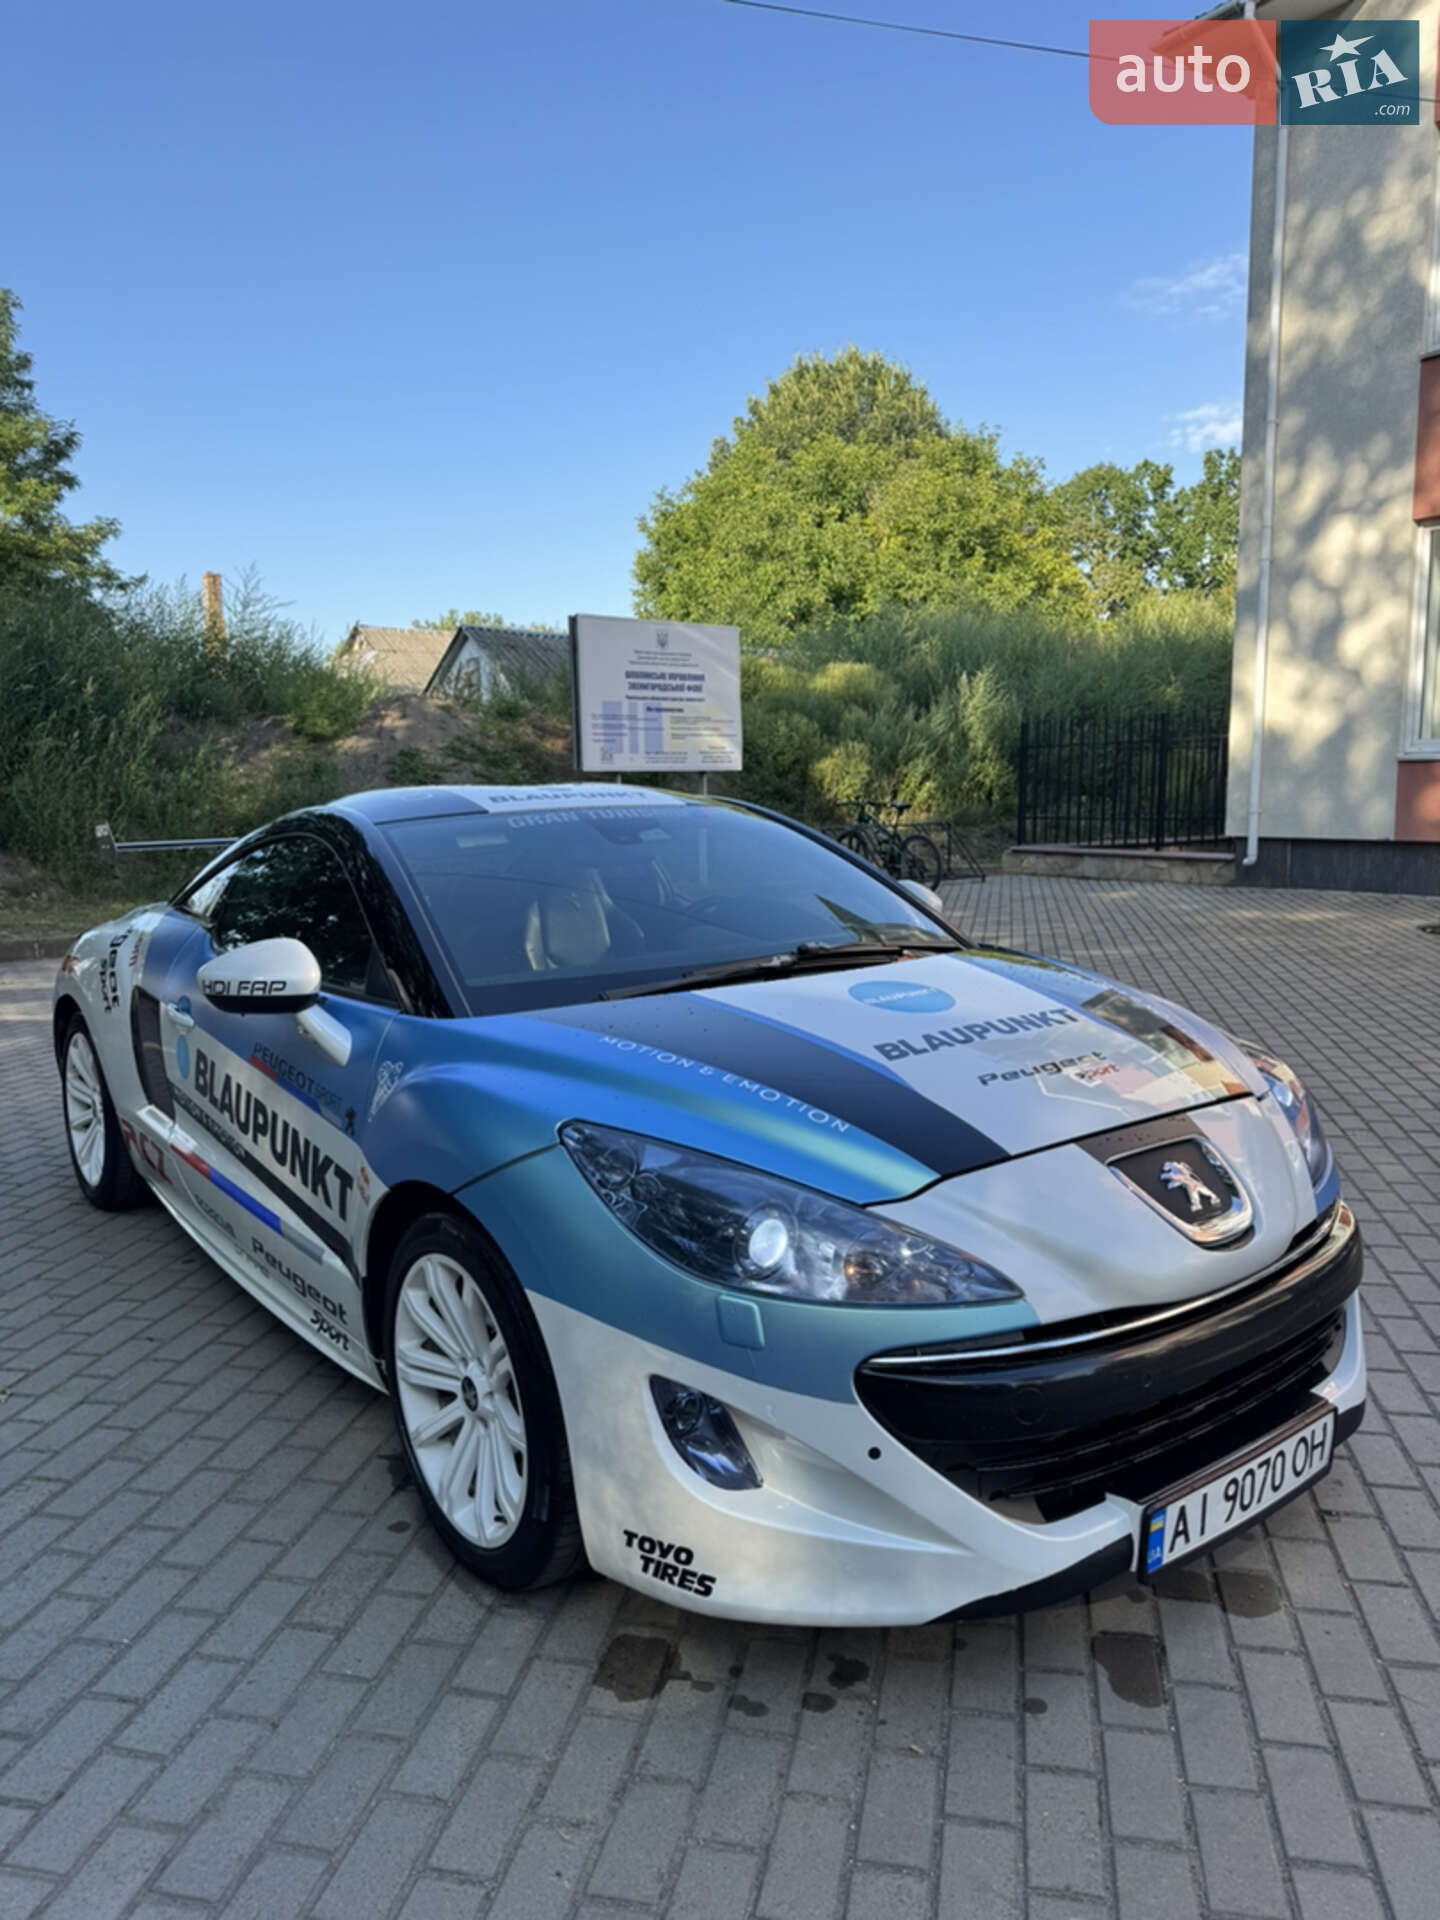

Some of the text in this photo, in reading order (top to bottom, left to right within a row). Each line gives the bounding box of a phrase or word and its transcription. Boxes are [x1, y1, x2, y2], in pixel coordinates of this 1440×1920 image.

[488, 790, 649, 804] BLAUPUNKT
[507, 811, 580, 829] GRAN
[237, 980, 287, 996] FAP
[873, 1008, 1079, 1062] BLAUPUNKT
[254, 1042, 316, 1093] PEUGEOT
[599, 1034, 850, 1133] MOTION & EMOTION
[195, 1047, 354, 1222] BLAUPUNKT
[252, 1237, 349, 1325] Peugeot
[1169, 1422, 1328, 1553] AI 9070 OH
[623, 1529, 694, 1566] TOYO
[640, 1555, 717, 1597] TIRES
